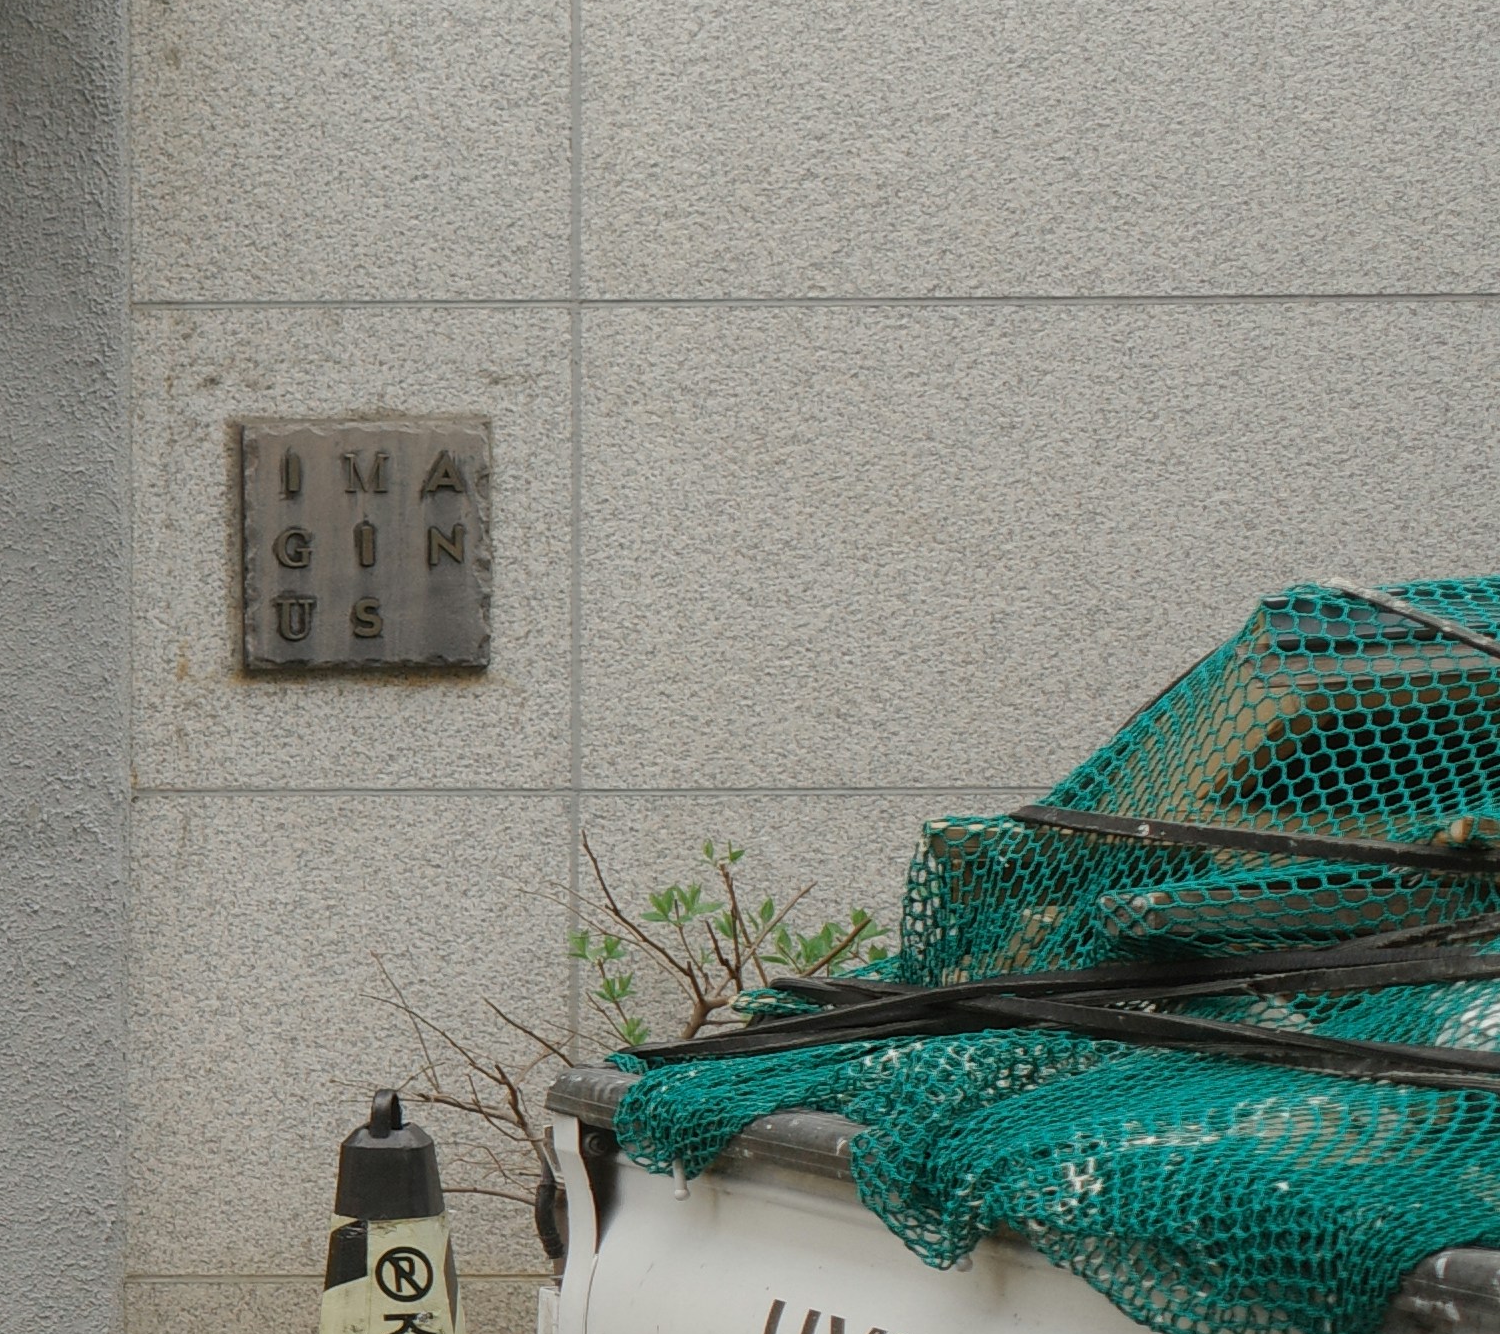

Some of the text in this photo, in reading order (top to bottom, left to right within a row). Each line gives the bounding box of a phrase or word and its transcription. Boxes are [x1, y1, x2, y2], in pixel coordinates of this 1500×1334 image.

[280, 448, 467, 497] IMA
[272, 520, 467, 569] GIN
[273, 594, 384, 642] US
